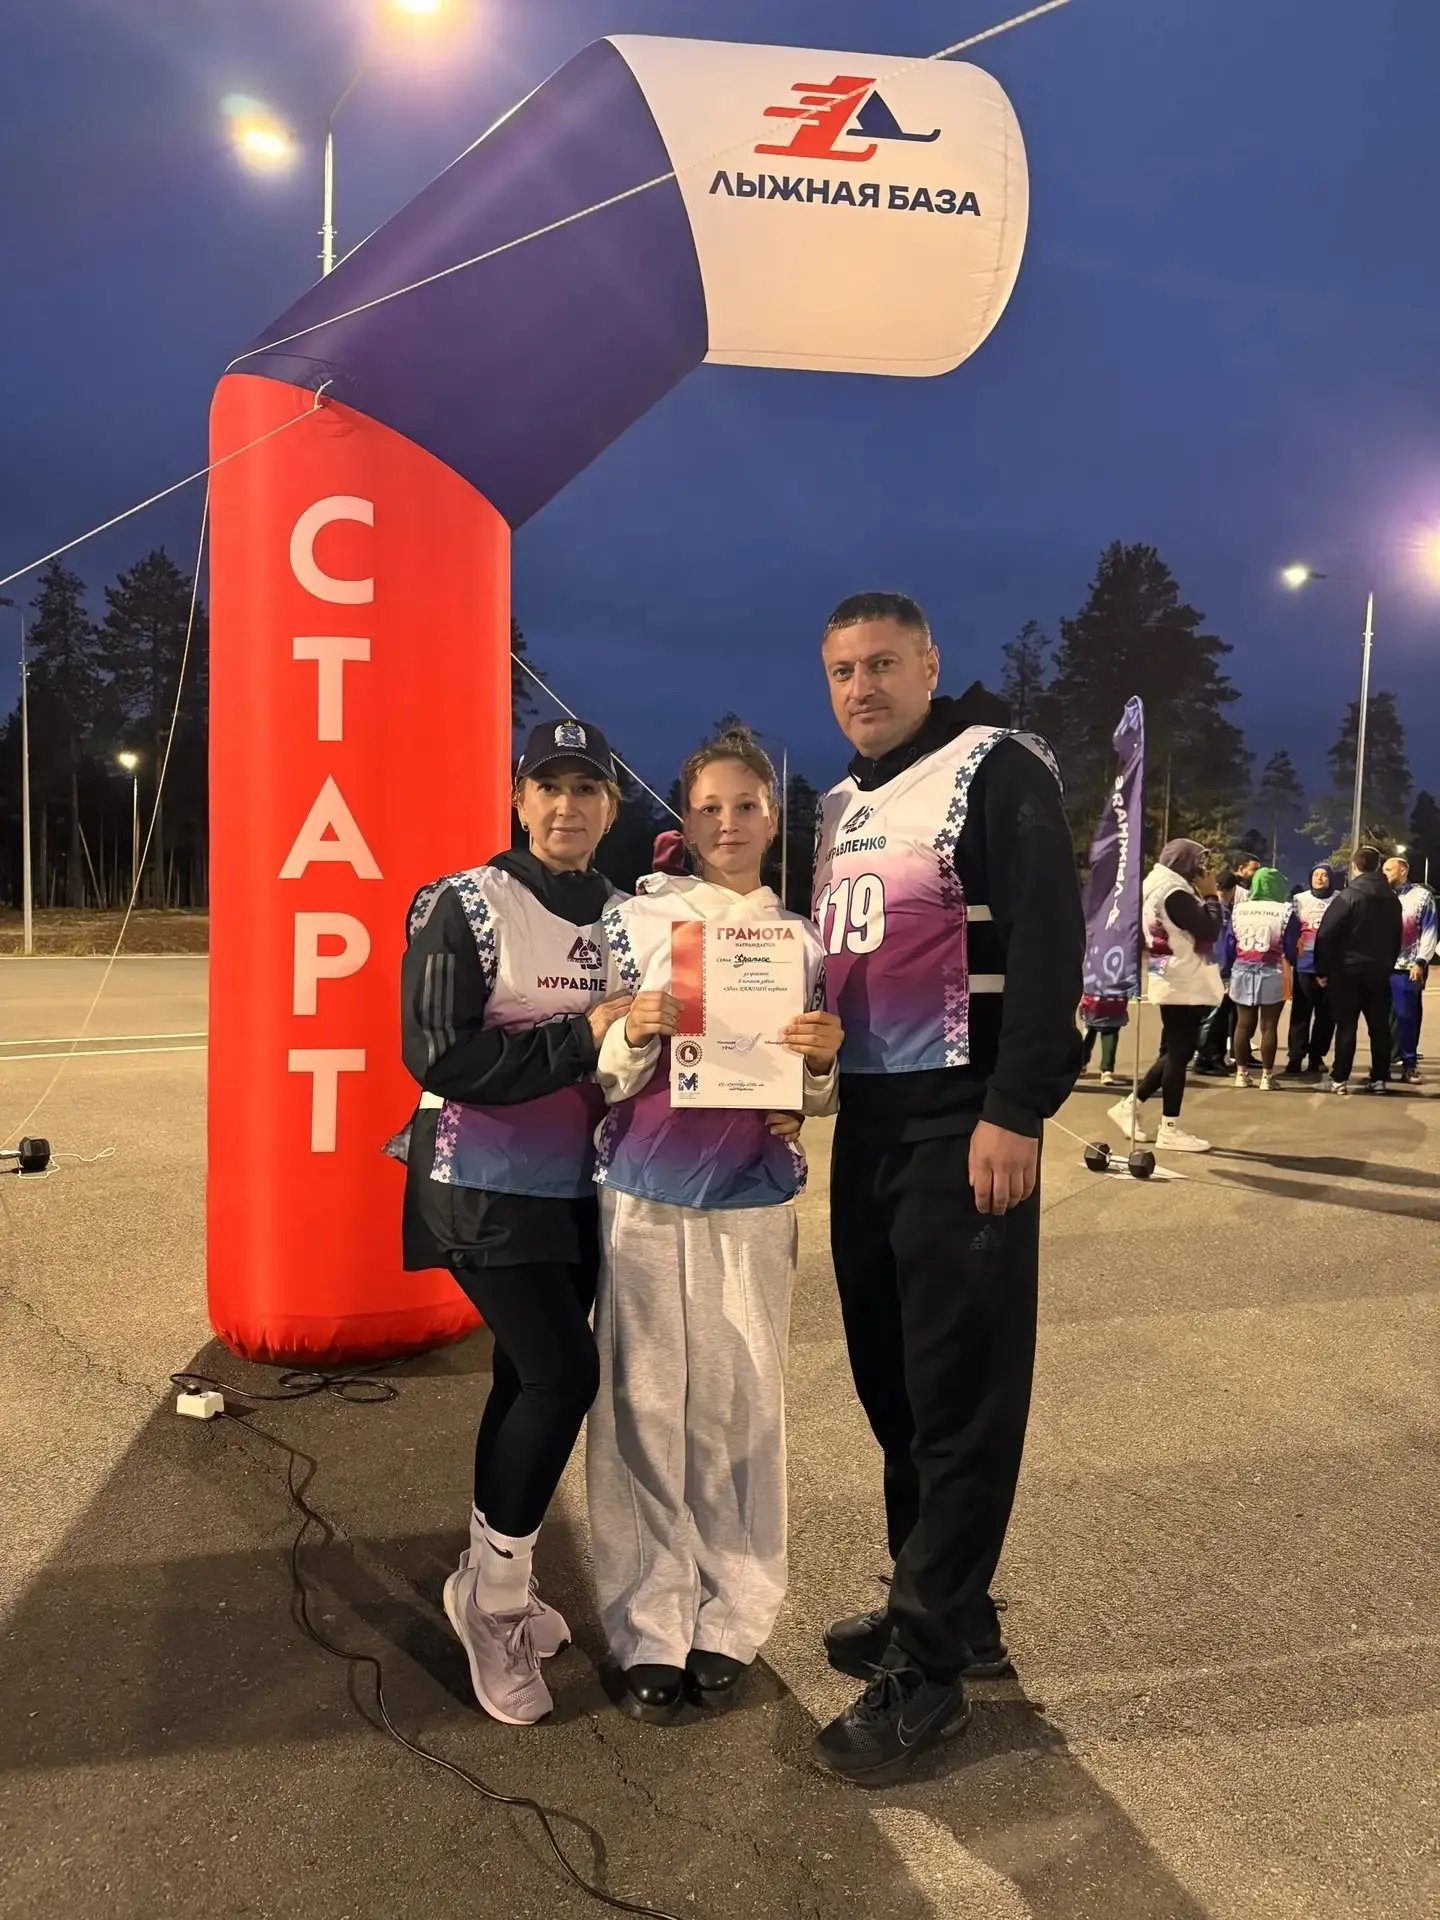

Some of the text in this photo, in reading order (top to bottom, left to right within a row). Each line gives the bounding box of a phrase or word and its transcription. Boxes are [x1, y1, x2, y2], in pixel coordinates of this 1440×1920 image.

[709, 170, 982, 217] ЛЫЖНАЯ БАЗА
[278, 494, 385, 1153] СТАРТ
[717, 927, 795, 940] ГРАМОТА
